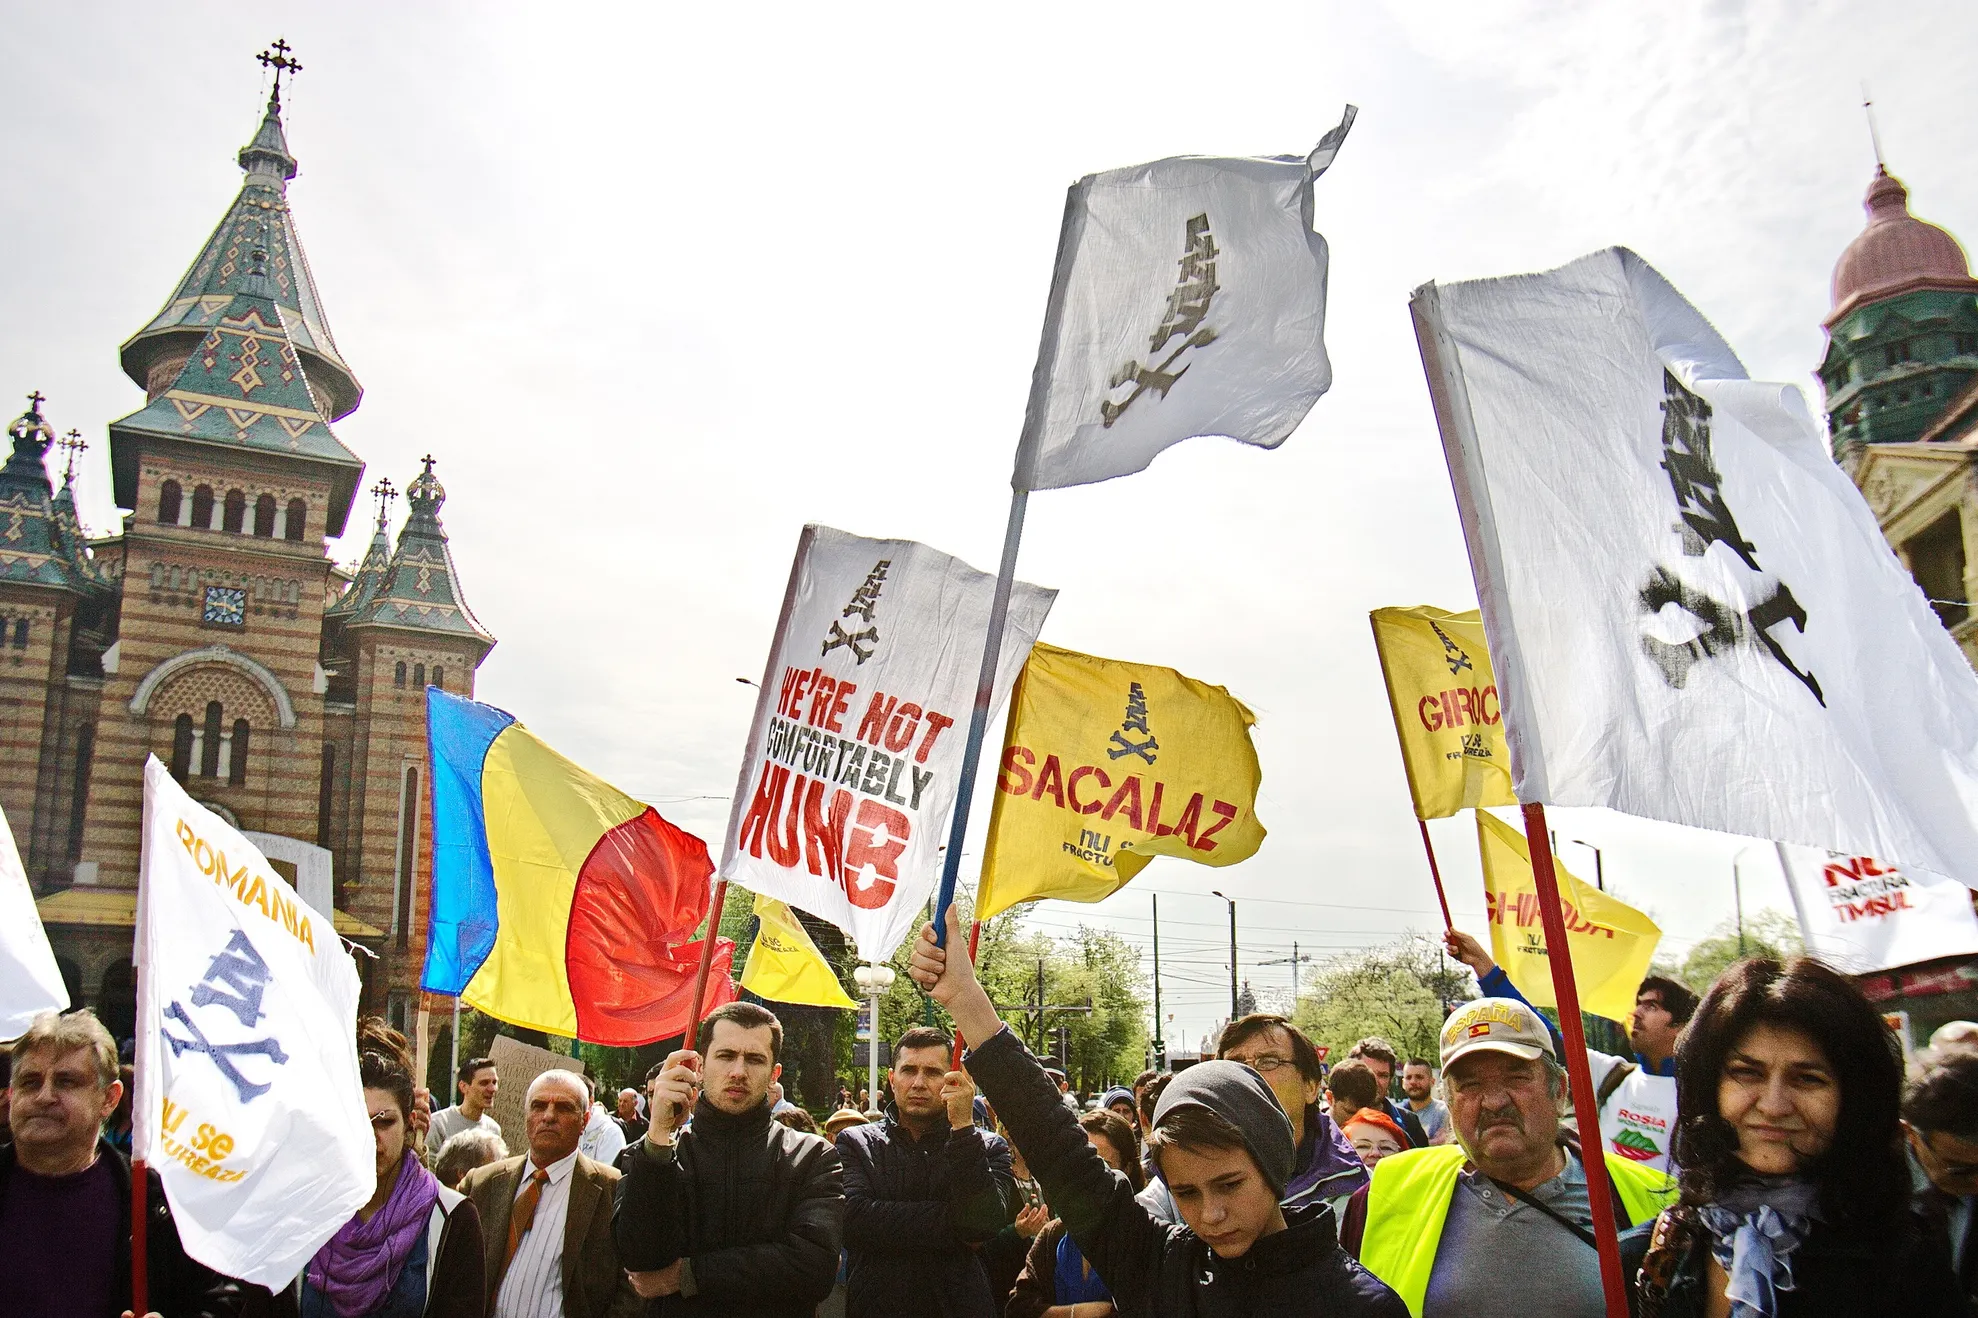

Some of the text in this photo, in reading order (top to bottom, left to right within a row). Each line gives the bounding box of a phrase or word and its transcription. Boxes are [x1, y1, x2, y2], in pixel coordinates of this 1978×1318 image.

[777, 666, 954, 763] WE'RE NOT
[766, 717, 933, 811] COMFORTABLY
[998, 745, 1238, 852] SACALAZ
[739, 760, 911, 910] NUMB
[1062, 841, 1114, 867] FRACTU
[176, 818, 317, 957] ROMANIA
[1447, 1003, 1522, 1045] ESPAÑA
[1618, 1108, 1667, 1129] ROSIA
